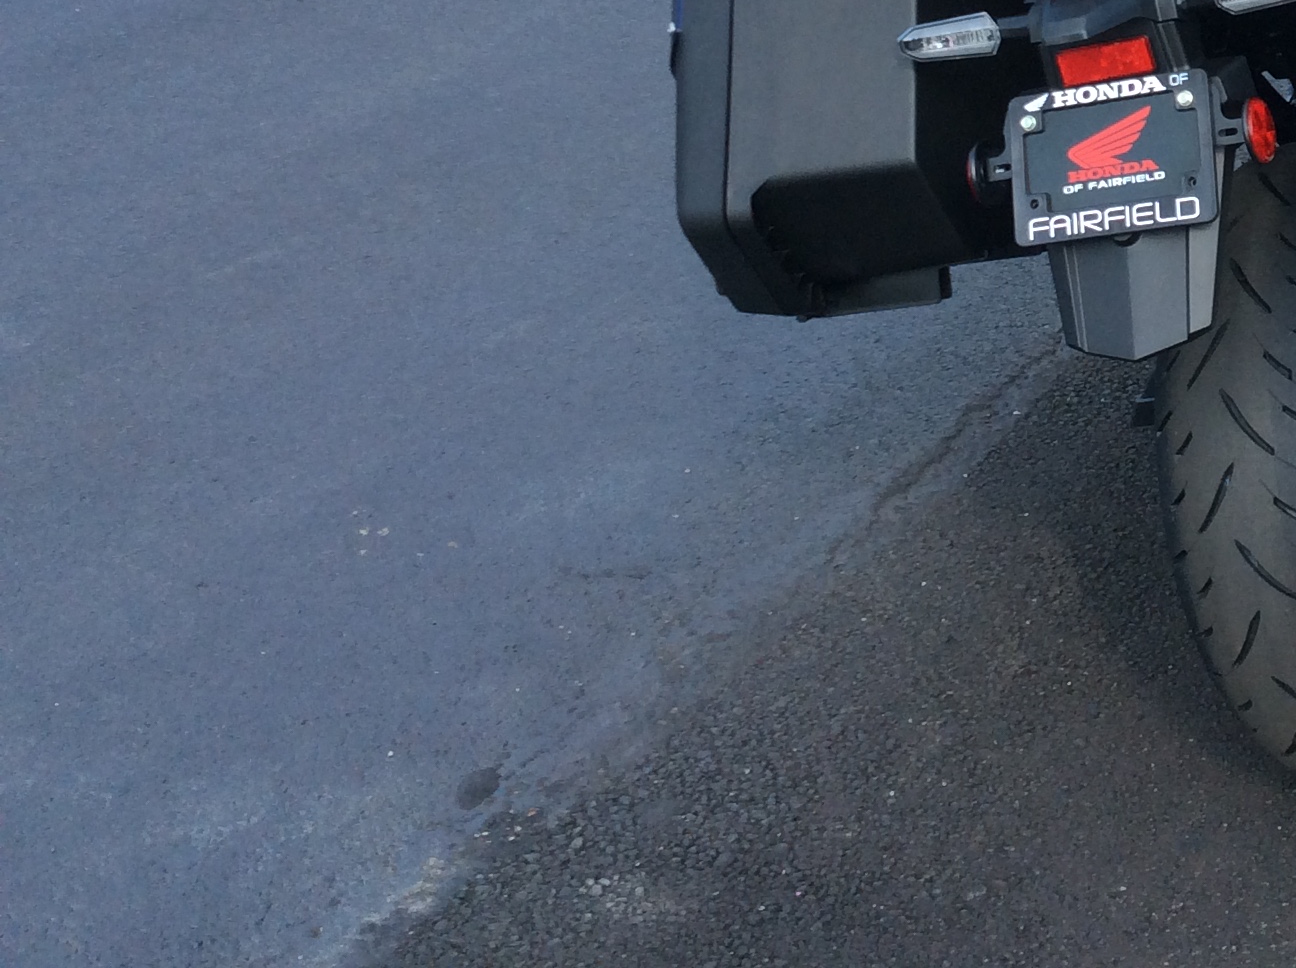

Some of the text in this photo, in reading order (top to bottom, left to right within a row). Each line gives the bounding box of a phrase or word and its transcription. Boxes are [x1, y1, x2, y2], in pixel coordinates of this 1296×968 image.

[1052, 72, 1190, 109] HONDA OF
[1063, 170, 1166, 196] OF FAIRFIELD
[1067, 159, 1160, 184] HONDA
[1028, 196, 1201, 242] FAIRFIELD
